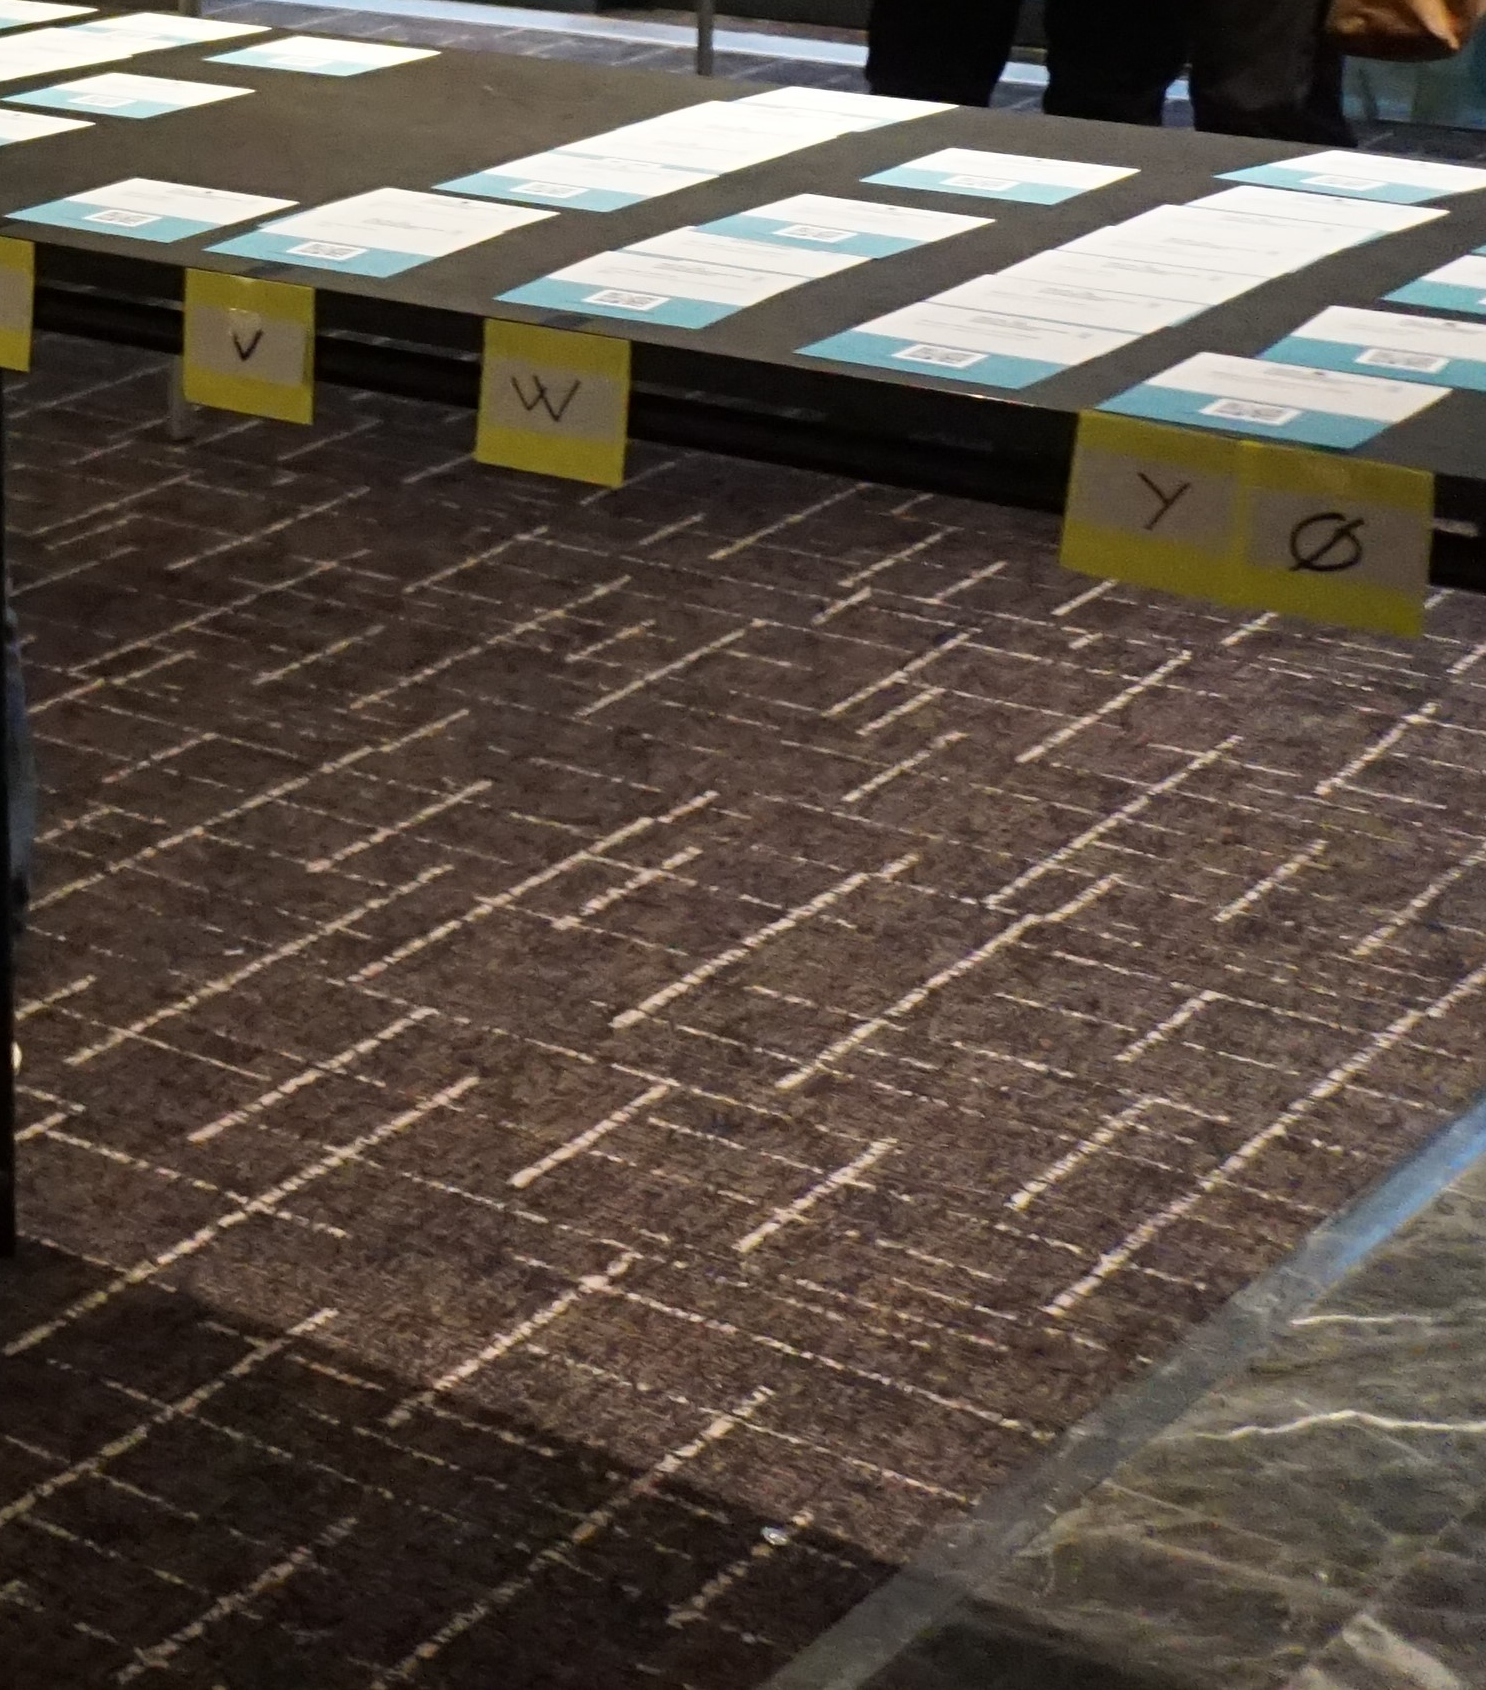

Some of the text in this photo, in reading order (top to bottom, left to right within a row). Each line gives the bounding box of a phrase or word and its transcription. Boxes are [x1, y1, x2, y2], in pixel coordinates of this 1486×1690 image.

[232, 327, 265, 362] V
[510, 373, 582, 423] W
[1137, 470, 1192, 531] Y
[1288, 510, 1366, 573] Ø
